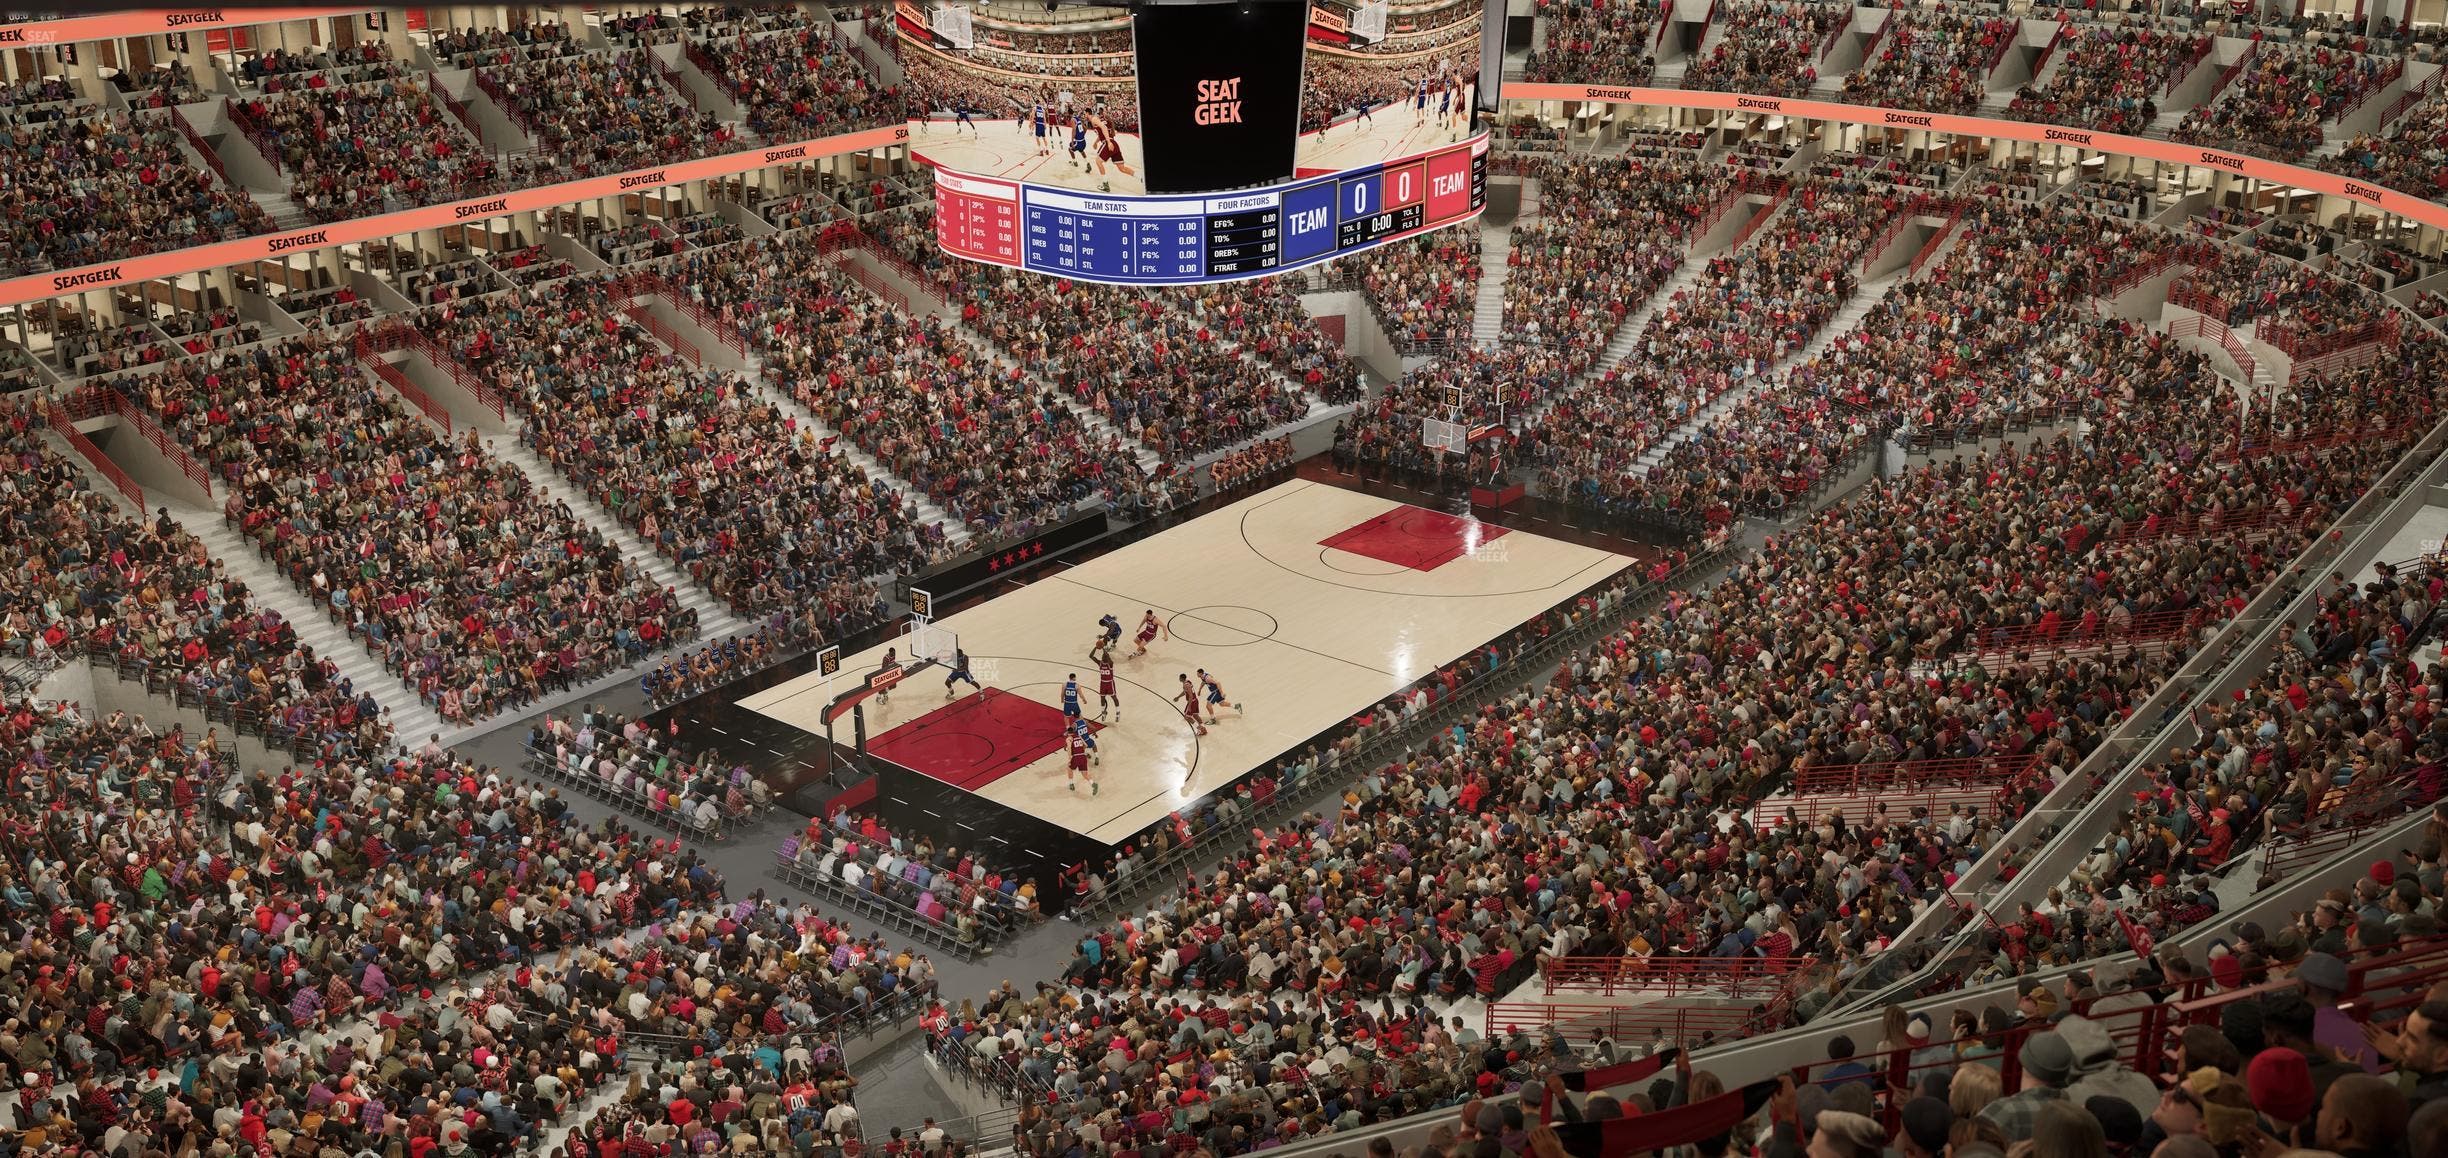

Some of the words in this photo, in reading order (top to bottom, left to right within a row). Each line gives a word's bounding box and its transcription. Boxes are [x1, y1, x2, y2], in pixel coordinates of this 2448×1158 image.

[166, 11, 224, 27] SEATGEEK
[1315, 11, 1343, 30] SEATGEEK
[1198, 77, 1240, 102] SEAT
[1586, 88, 1631, 100] SEATGEEK
[1737, 97, 1781, 111] SEATGEEK
[1195, 101, 1242, 125] GEEK
[1885, 112, 1932, 127] SEATGEEK
[2045, 129, 2092, 145] SEATGEEK
[766, 146, 807, 162] SEATGEEK
[2201, 152, 2244, 171] SEATGEEK
[620, 170, 666, 189] SEATGEEK
[1398, 171, 1410, 202] 0
[1433, 171, 1464, 198] TEAM
[1354, 182, 1366, 214] 0
[2344, 183, 2383, 204] SEATGEEK
[456, 199, 508, 218] SEATGEEK
[1084, 201, 1103, 210] TEAM
[1105, 203, 1127, 212] STATS
[1218, 200, 1238, 210] FOUR
[1240, 196, 1270, 208] FACTORS
[1416, 206, 1420, 214] 0
[1031, 211, 1040, 219] AST
[1058, 215, 1072, 225] 0.00
[1082, 219, 1093, 228] BLK
[1122, 223, 1127, 231] 0
[1214, 220, 1234, 228] EFG%
[1262, 214, 1276, 223] 0.00
[1289, 206, 1327, 236] TEAM
[1372, 214, 1392, 233] 0:00
[1402, 220, 1413, 229] FLS
[1415, 218, 1419, 226] 0
[1032, 225, 1046, 234] OREB
[1059, 230, 1072, 239] 0.00
[1179, 222, 1196, 231] 0.00
[1343, 225, 1354, 233] TOL
[1357, 222, 1361, 230] 0
[269, 231, 328, 252] SEATGEEK
[1122, 237, 1127, 245] 0
[1179, 236, 1196, 245] 0.00
[1214, 235, 1230, 243] TO%
[1262, 228, 1276, 238] 0.00
[1343, 238, 1354, 246] FLS
[1357, 234, 1361, 242] 0
[1032, 239, 1046, 247] DREB
[1059, 244, 1072, 253] 0.00
[1082, 248, 1094, 256] POT
[1123, 251, 1128, 259] 0
[1214, 249, 1239, 258] OREB%
[1262, 242, 1276, 252] 0.00
[1032, 252, 1042, 260] STL
[1060, 257, 1073, 267] 0.00
[1179, 250, 1196, 259] 0.00
[1083, 261, 1093, 269] STL
[1123, 265, 1128, 273] 0
[1179, 264, 1196, 273] 0.00
[1214, 263, 1237, 273] FTRATE
[1262, 257, 1276, 267] 0.00
[54, 267, 122, 291] SEATGEEK
[874, 670, 899, 685] SEATGEEK
[1078, 727, 1088, 735] 00
[850, 954, 859, 967] 00
[936, 1016, 949, 1031] 00
[790, 1094, 805, 1111] 00
